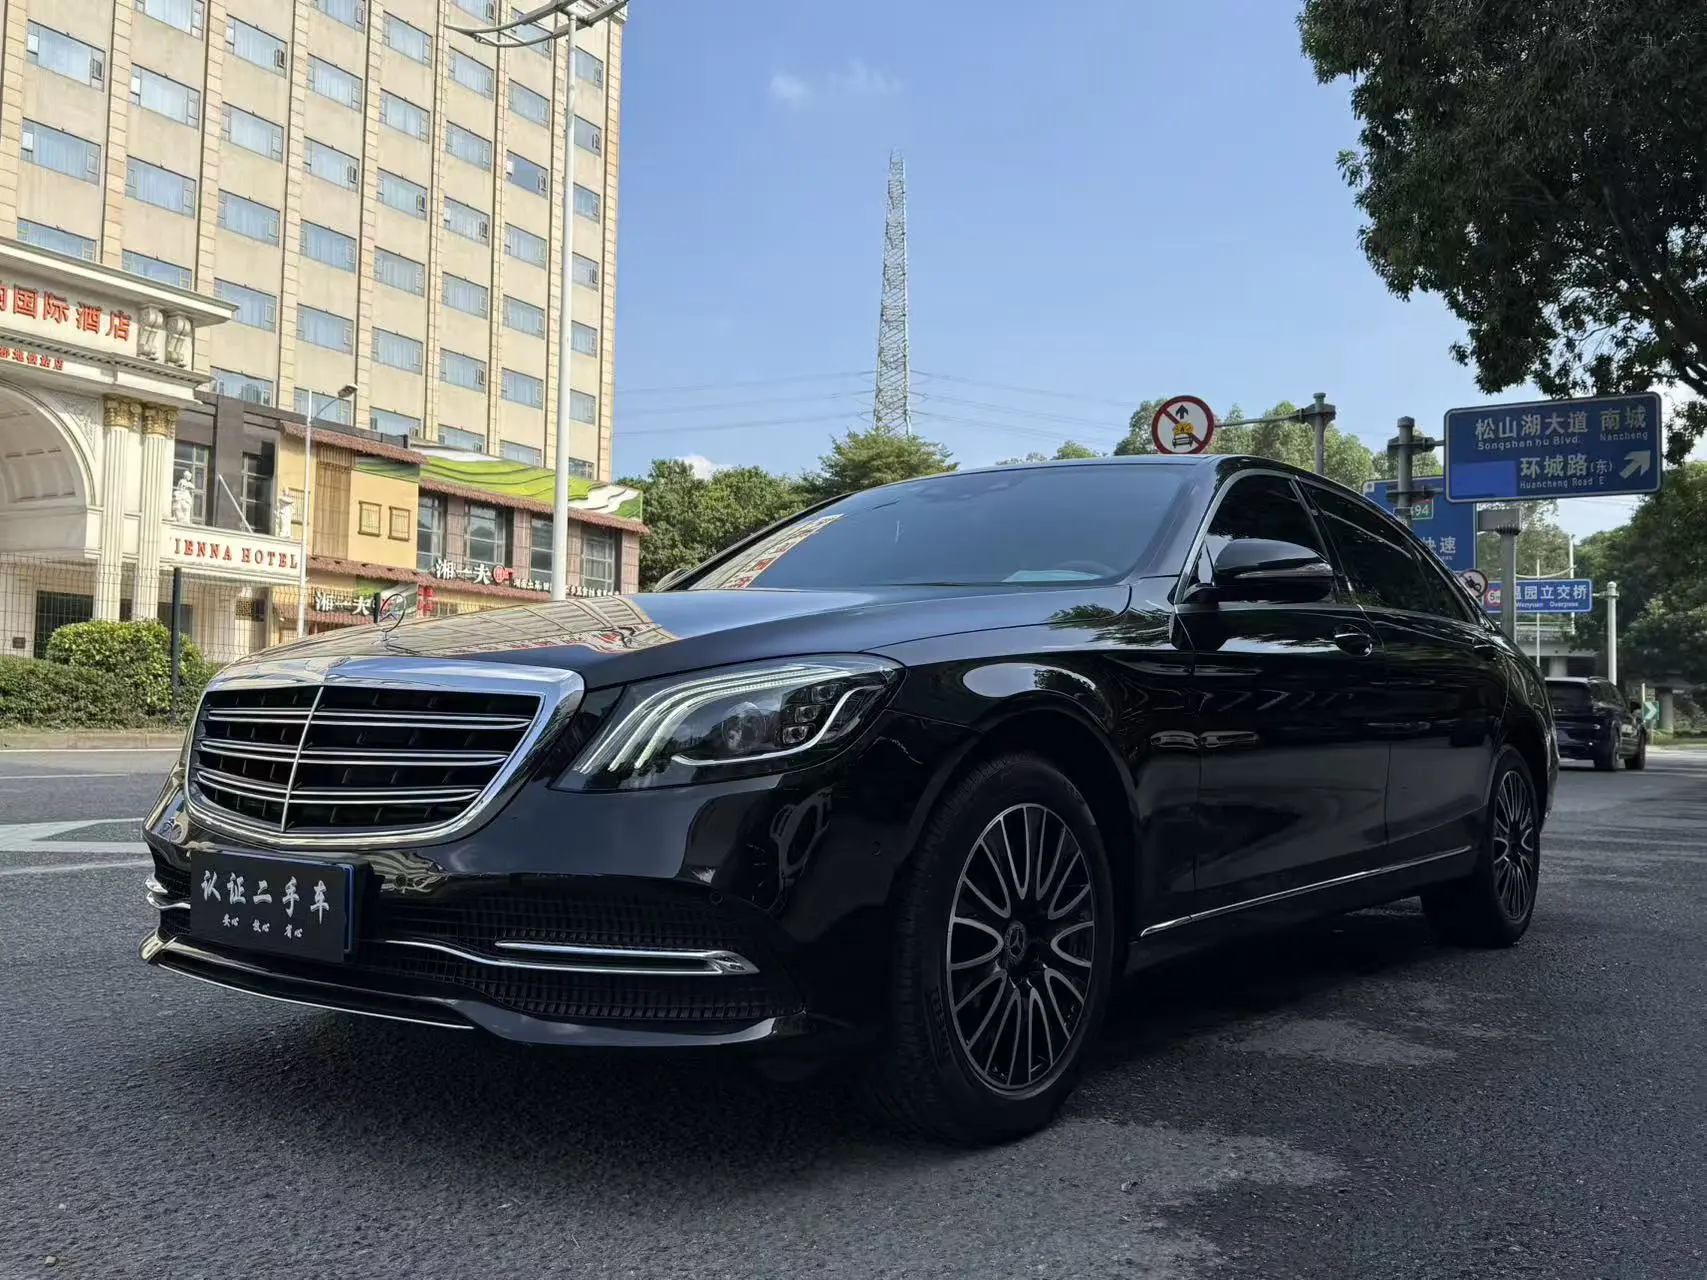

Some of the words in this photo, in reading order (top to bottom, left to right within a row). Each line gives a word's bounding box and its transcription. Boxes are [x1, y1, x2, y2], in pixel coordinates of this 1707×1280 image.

[1475, 411, 1588, 440] 松山湖大道
[1600, 405, 1647, 431] 南城
[1571, 477, 1593, 487] Road
[1411, 503, 1429, 517] 94
[241, 547, 298, 569] HOTEL
[200, 869, 330, 925] 认证二手车
